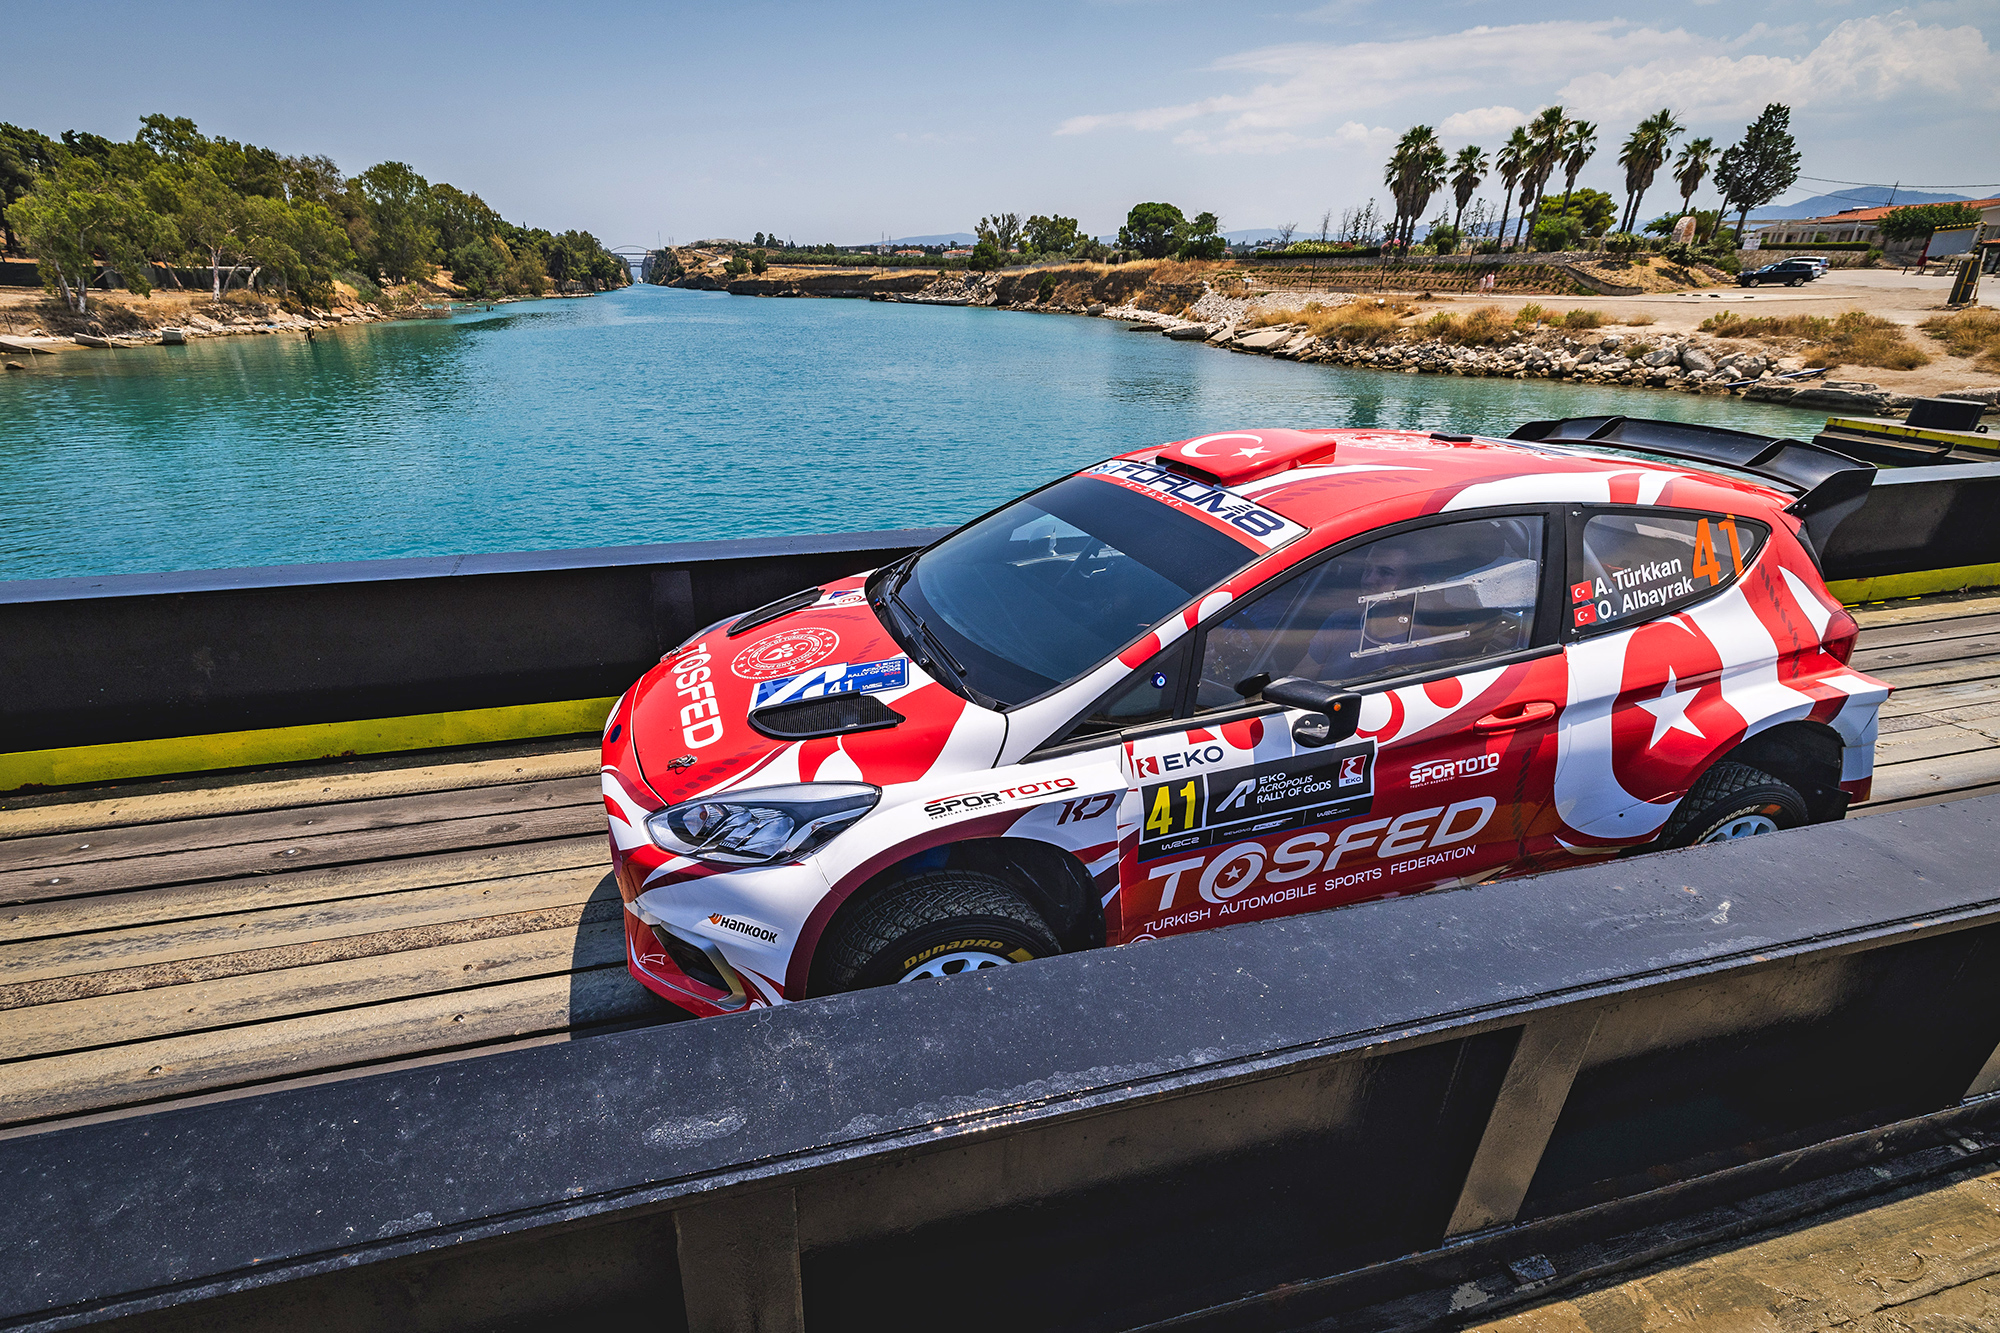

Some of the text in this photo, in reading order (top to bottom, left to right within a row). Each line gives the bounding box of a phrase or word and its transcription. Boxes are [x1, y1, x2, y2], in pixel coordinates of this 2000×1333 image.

[1108, 464, 1285, 537] FORUM8
[1119, 479, 1184, 508] フォーラムエイト
[1692, 513, 1744, 587] 41
[1594, 557, 1682, 598] A. Türkkan
[1597, 576, 1695, 619] O. Albayrak
[670, 642, 724, 750] TOSFED
[828, 679, 854, 694] 41
[1162, 745, 1224, 772] EKO
[1256, 780, 1332, 804] RALLY OF GODS
[1257, 775, 1314, 795] ACROPOLIS
[1259, 772, 1287, 785] EKO
[1345, 776, 1362, 784] EKO
[1147, 780, 1196, 835] 41
[1148, 796, 1497, 912] TOSFED
[1161, 837, 1200, 851] WRC2
[1143, 844, 1477, 934] TURKISH AUTOMOBILE SPORTS FEDERATION
